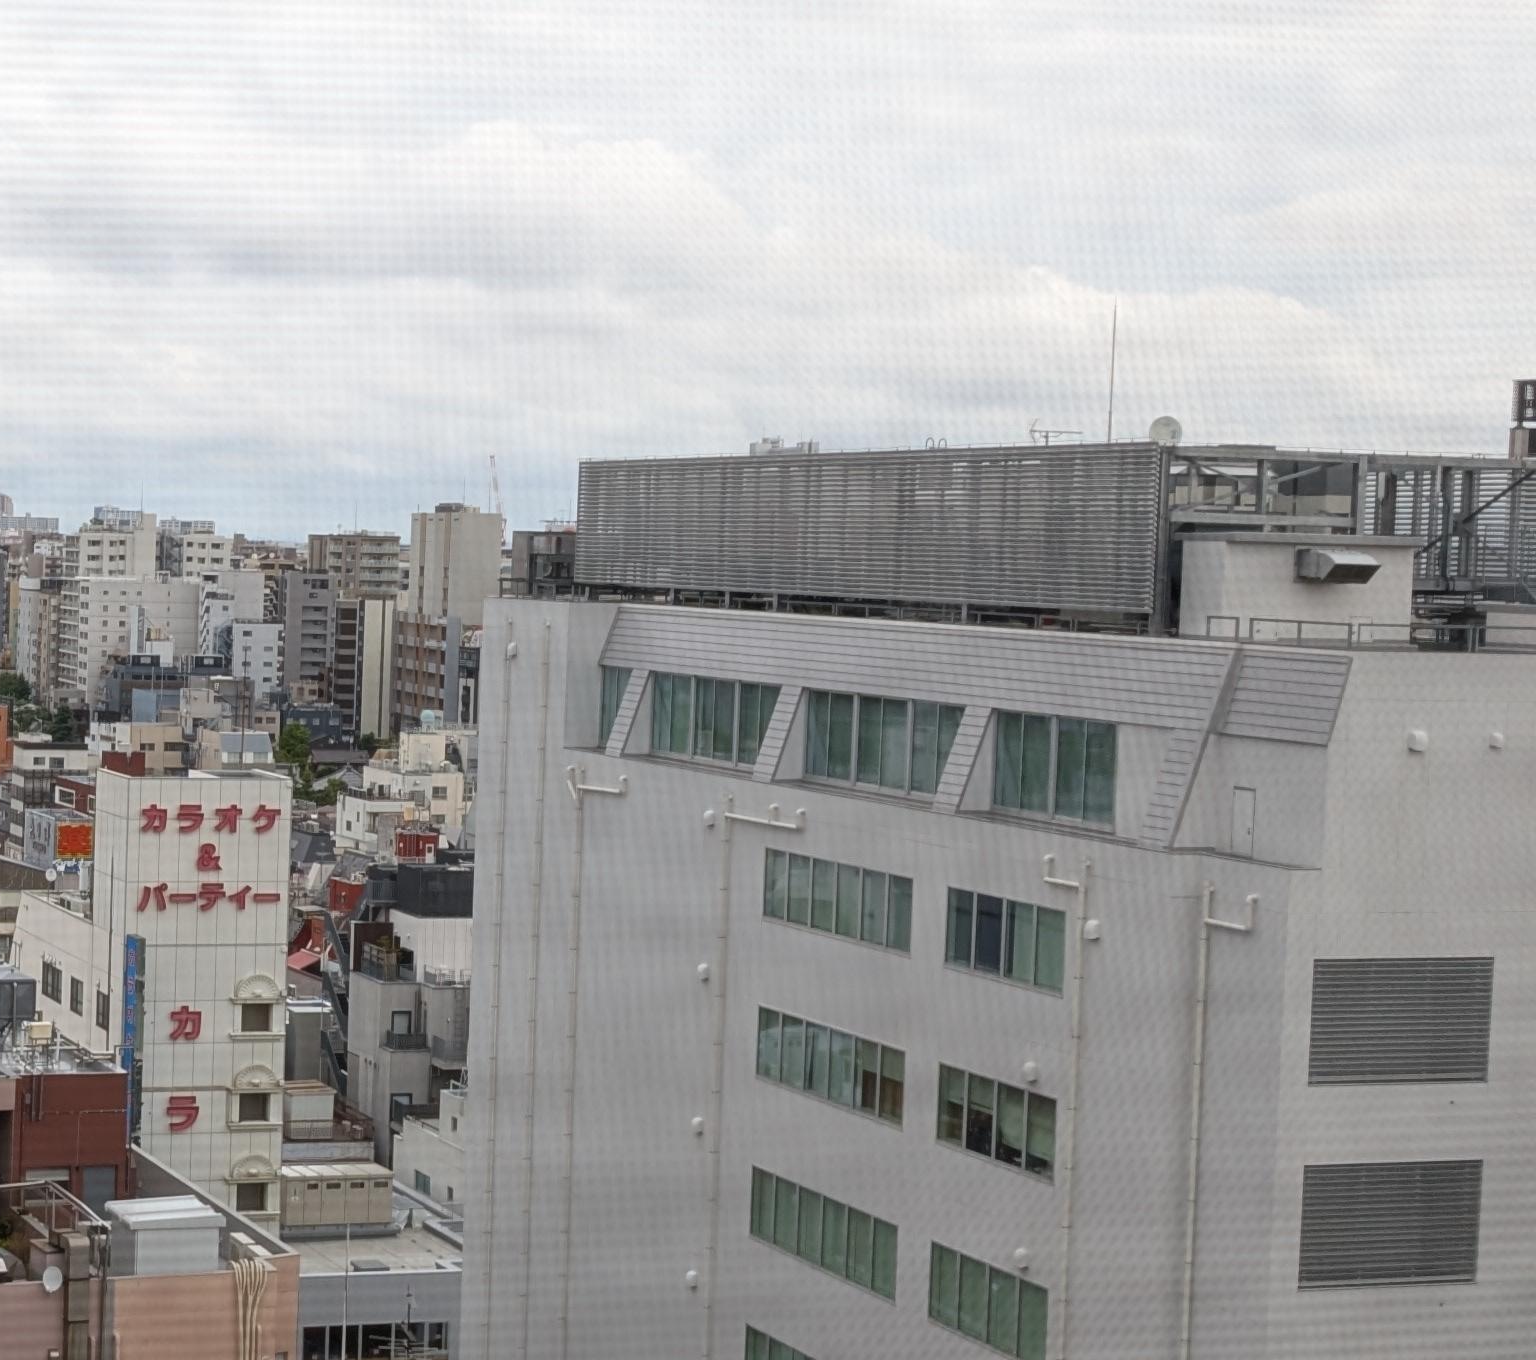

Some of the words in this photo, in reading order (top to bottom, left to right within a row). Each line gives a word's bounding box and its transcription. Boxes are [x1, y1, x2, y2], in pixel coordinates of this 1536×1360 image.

[141, 804, 281, 833] カラオケ
[197, 843, 222, 871] &
[137, 883, 280, 912] パーティー
